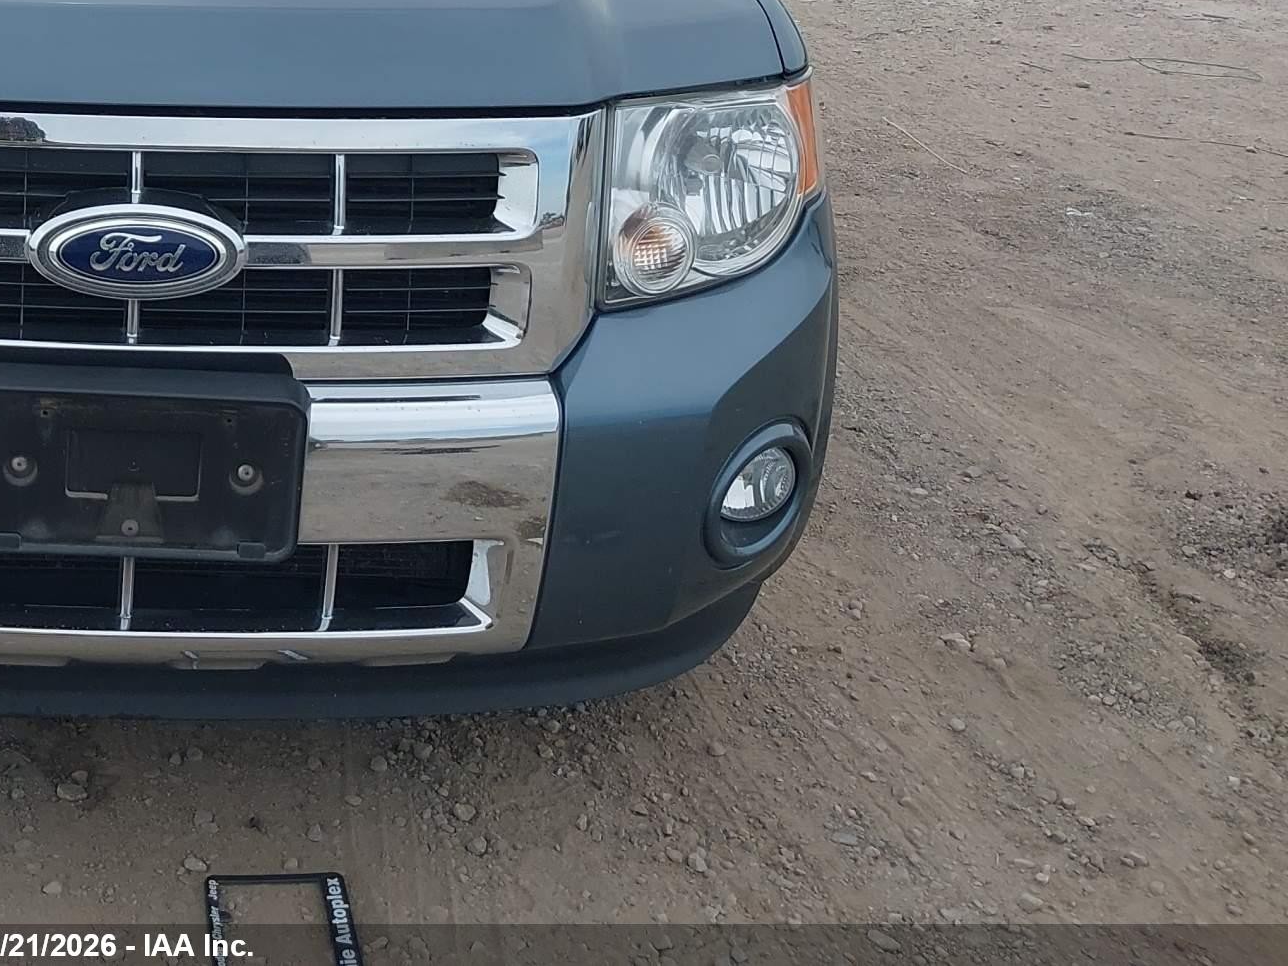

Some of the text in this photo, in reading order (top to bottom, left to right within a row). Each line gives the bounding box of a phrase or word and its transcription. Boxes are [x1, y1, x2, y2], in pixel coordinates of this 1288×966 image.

[89, 232, 186, 273] Ford
[208, 879, 219, 900] Jeep
[209, 906, 223, 940] Chrysler
[326, 878, 353, 945] Autoplex
